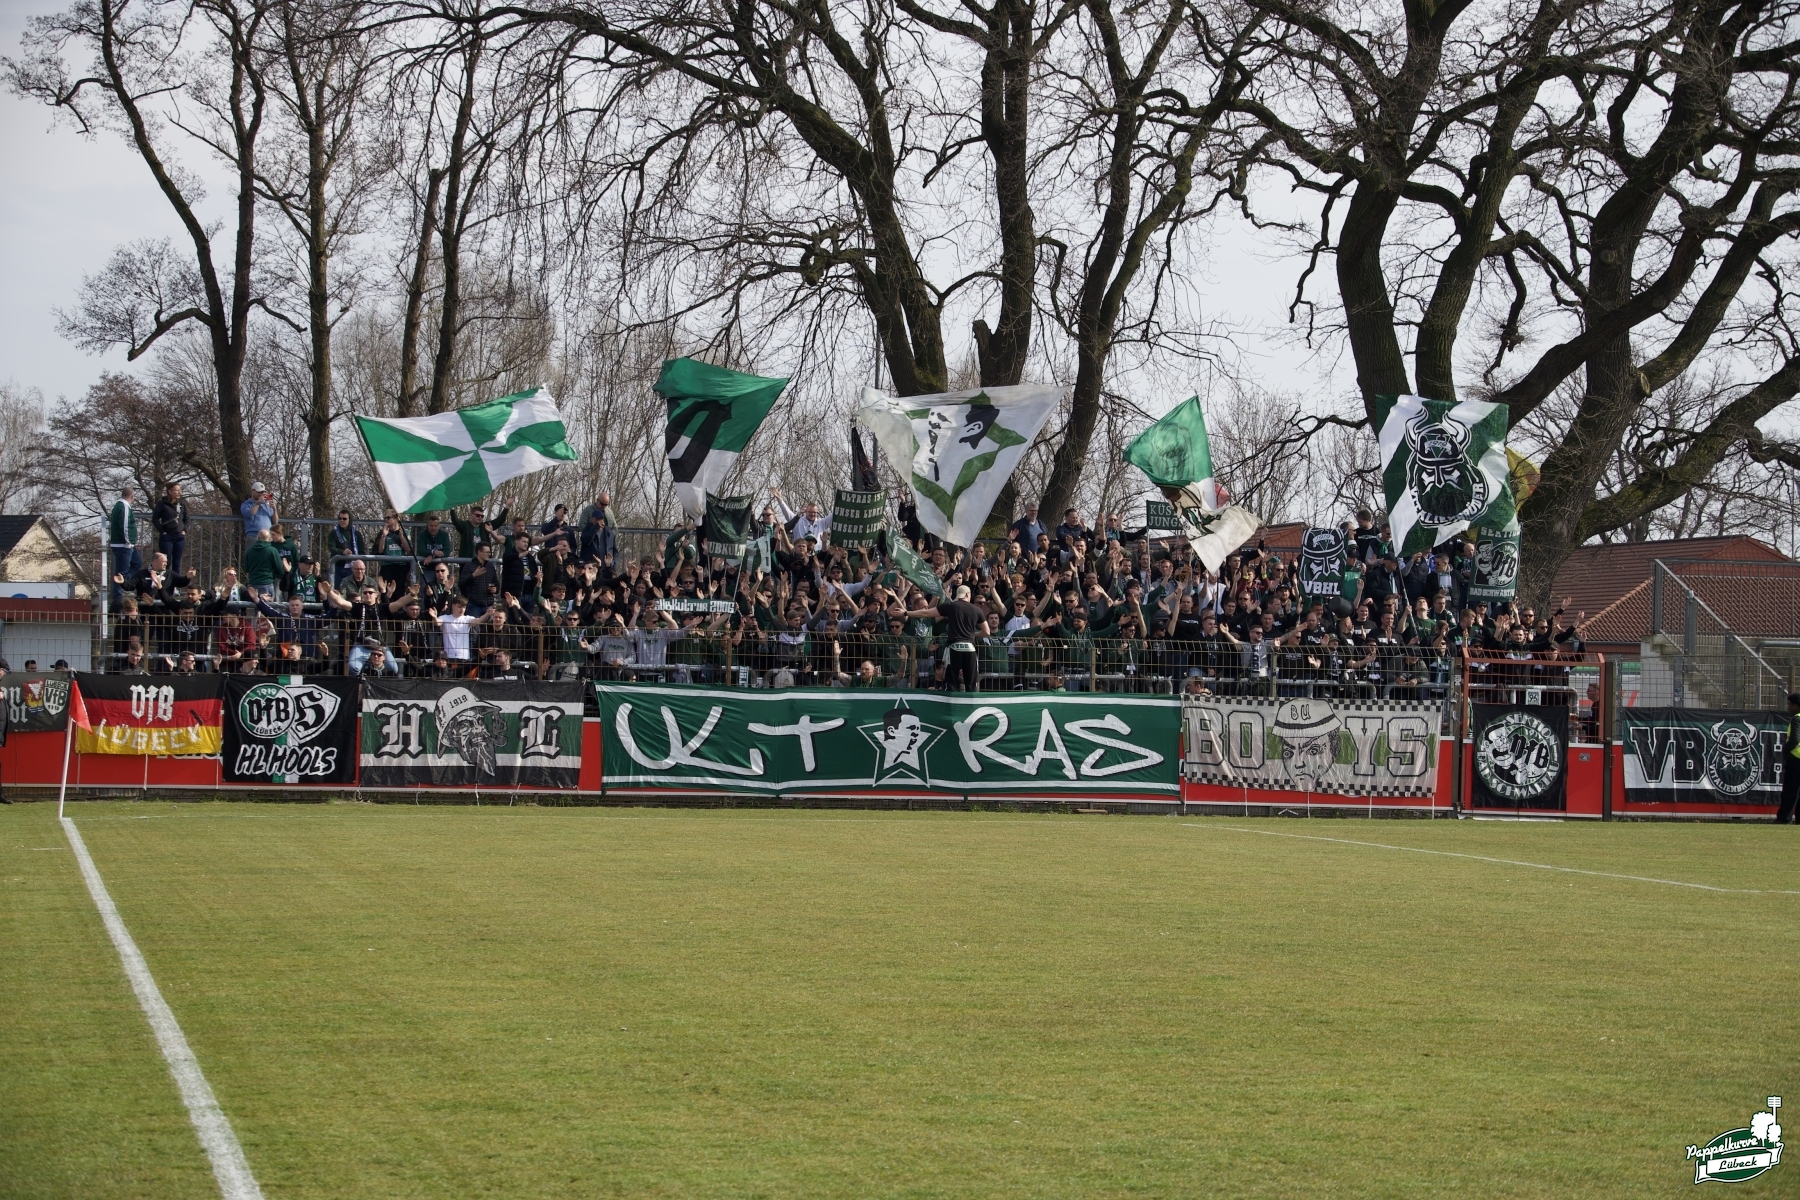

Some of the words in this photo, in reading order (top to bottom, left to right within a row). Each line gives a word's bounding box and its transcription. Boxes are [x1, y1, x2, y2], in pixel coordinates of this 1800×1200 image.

[841, 491, 872, 504] ULTRAS
[834, 506, 861, 519] UNSER
[832, 521, 864, 534] UNSERE
[1148, 516, 1182, 528] JUNG
[1302, 580, 1341, 595] VBHL
[1469, 587, 1482, 596] BAD
[709, 600, 735, 614] 2006
[45, 687, 68, 707] VfB
[256, 687, 278, 697] 1919
[448, 694, 468, 709] 1919
[95, 717, 203, 751] LÜBECK
[255, 726, 283, 736] LÜBECK
[1505, 713, 1559, 746] SEKTION
[266, 744, 337, 777] HOOLS
[1708, 763, 1760, 793] VITALIENBRÜDER
